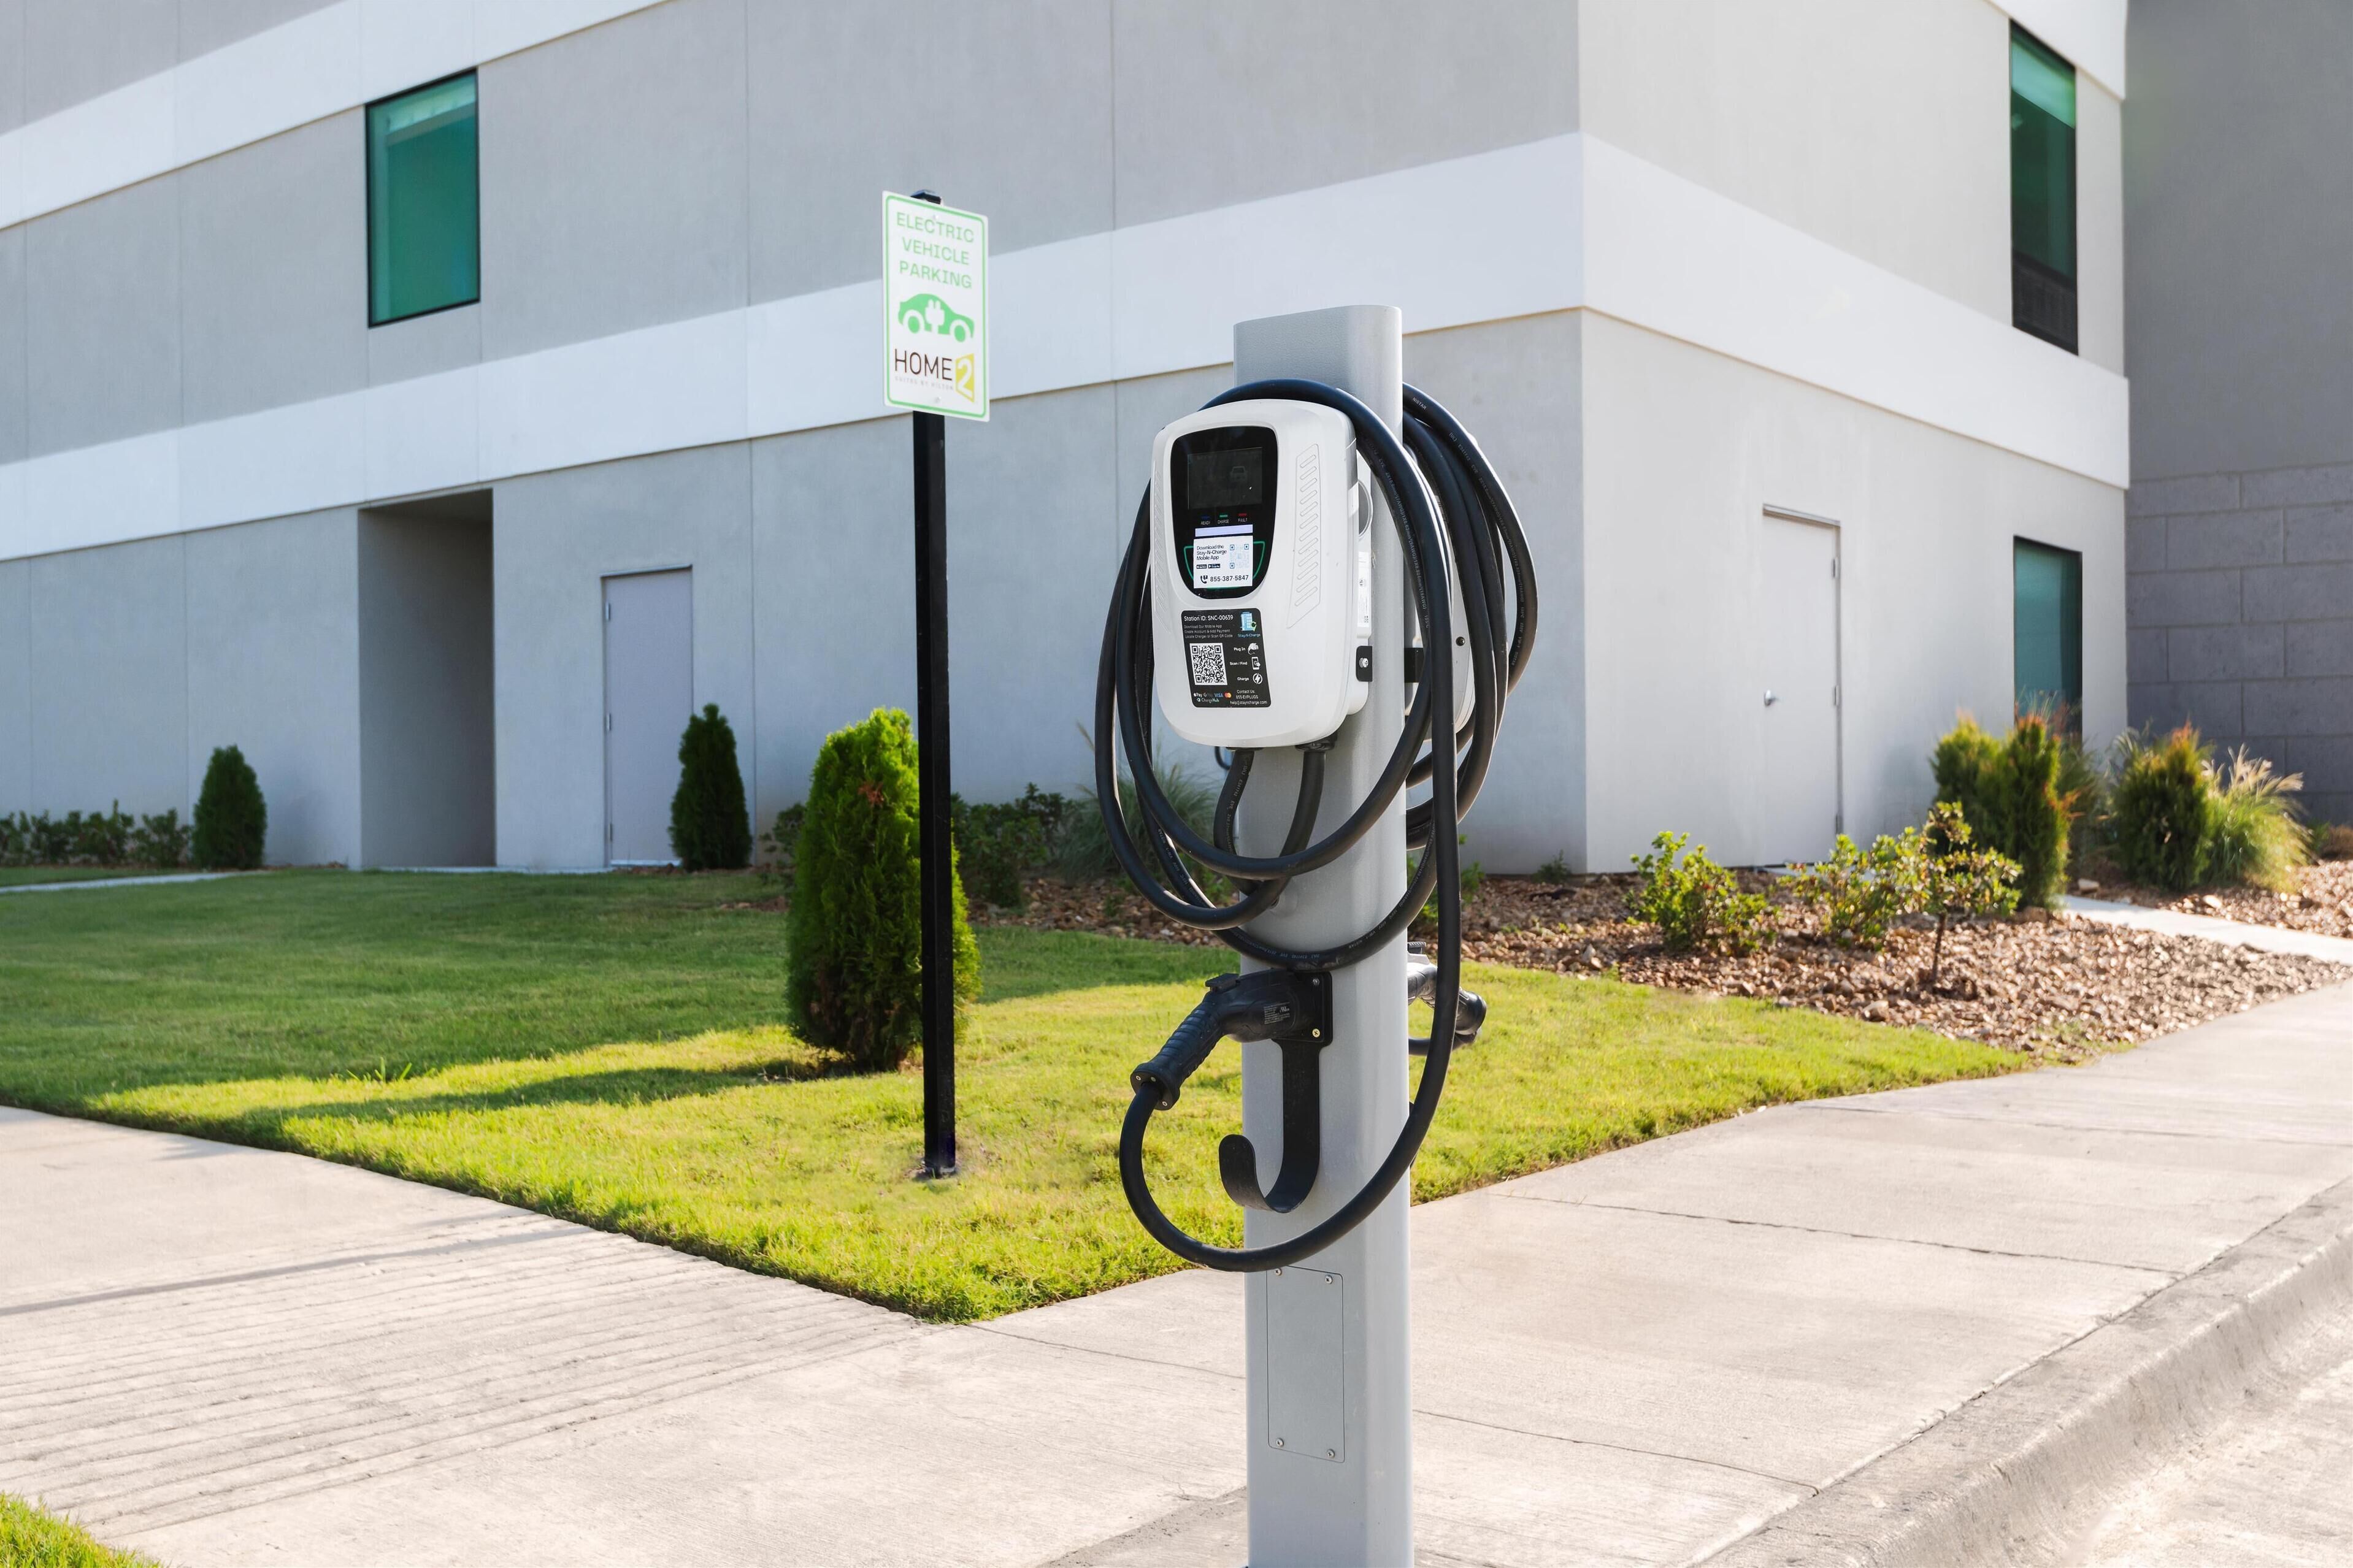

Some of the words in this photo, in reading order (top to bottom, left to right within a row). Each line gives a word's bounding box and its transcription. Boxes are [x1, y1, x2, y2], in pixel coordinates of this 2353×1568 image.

[896, 211, 975, 243] ELECTRIC
[902, 236, 970, 266] VEHICLE
[899, 260, 972, 289] PARKING
[1412, 397, 1427, 410] NISTAR
